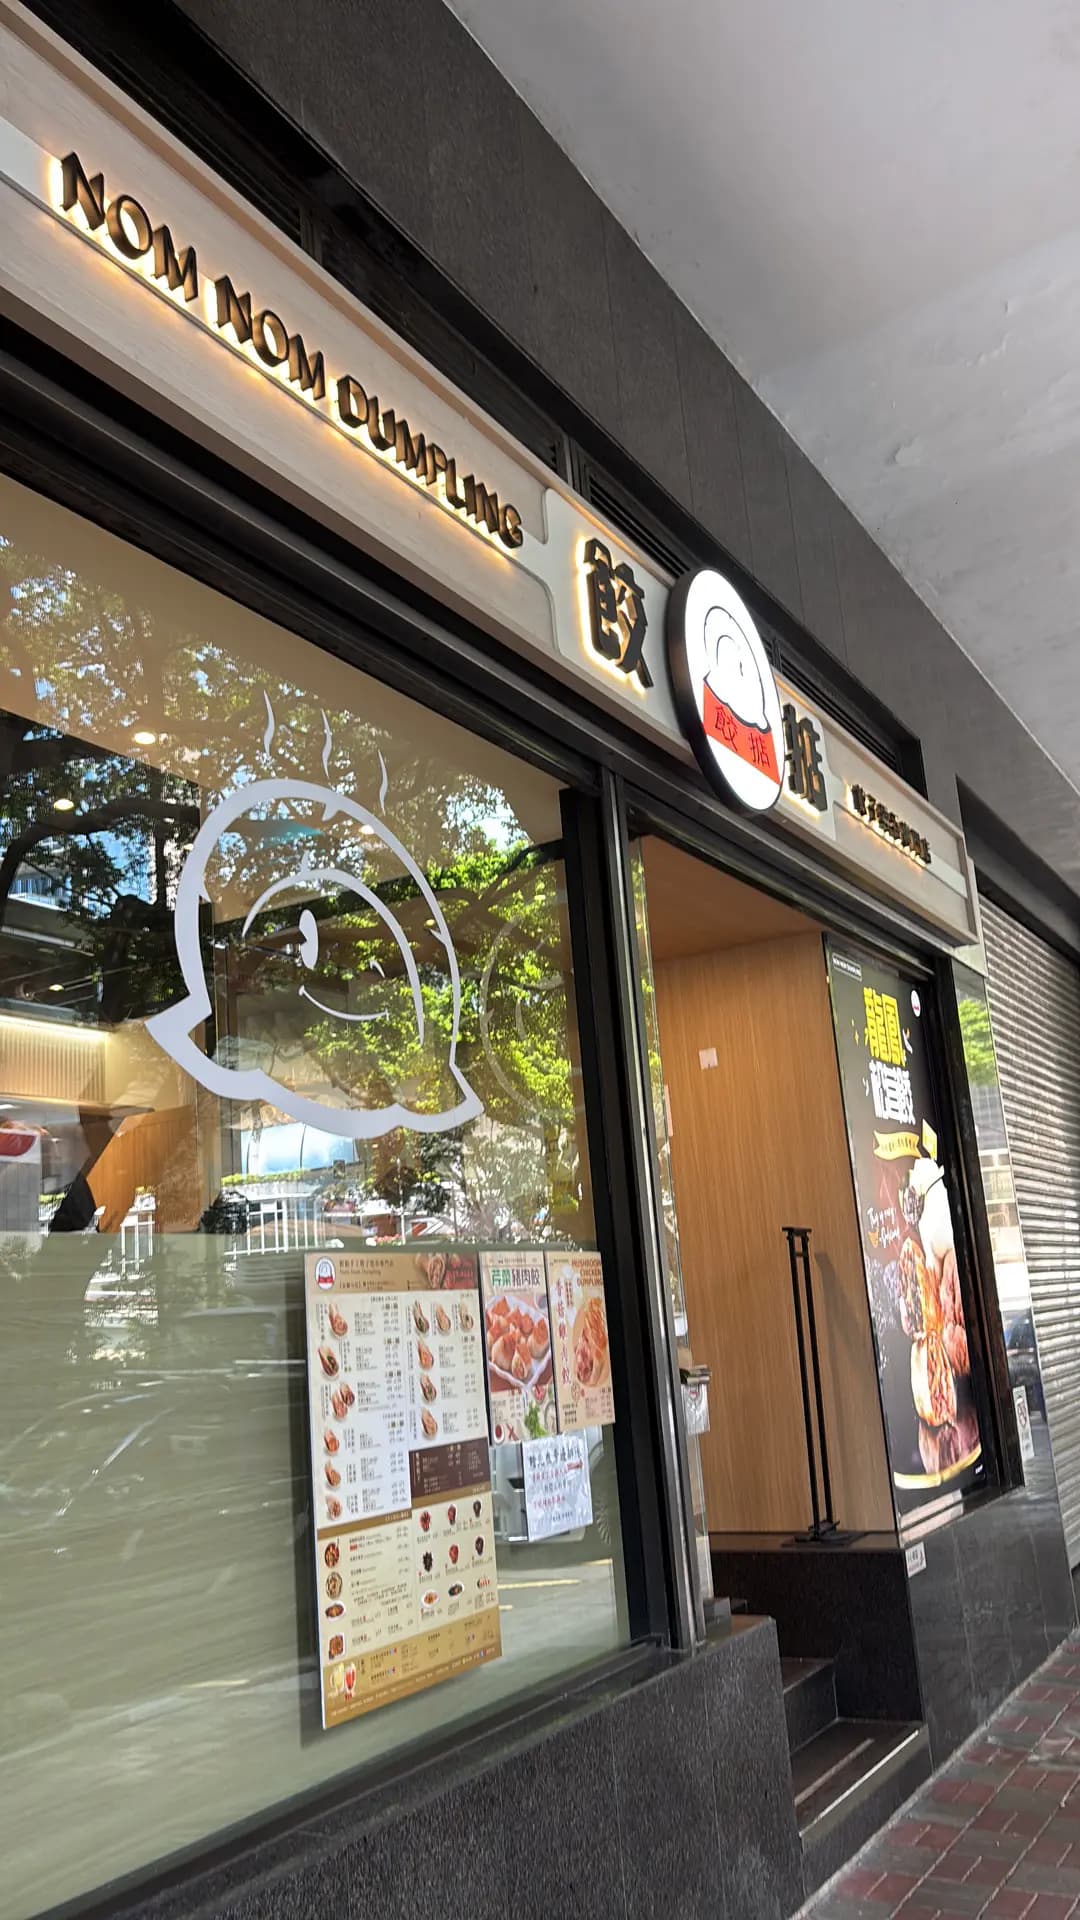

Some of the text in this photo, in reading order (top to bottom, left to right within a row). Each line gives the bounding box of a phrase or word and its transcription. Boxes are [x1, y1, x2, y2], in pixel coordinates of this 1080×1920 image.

[59, 151, 524, 550] NOM NOM DUMPLING
